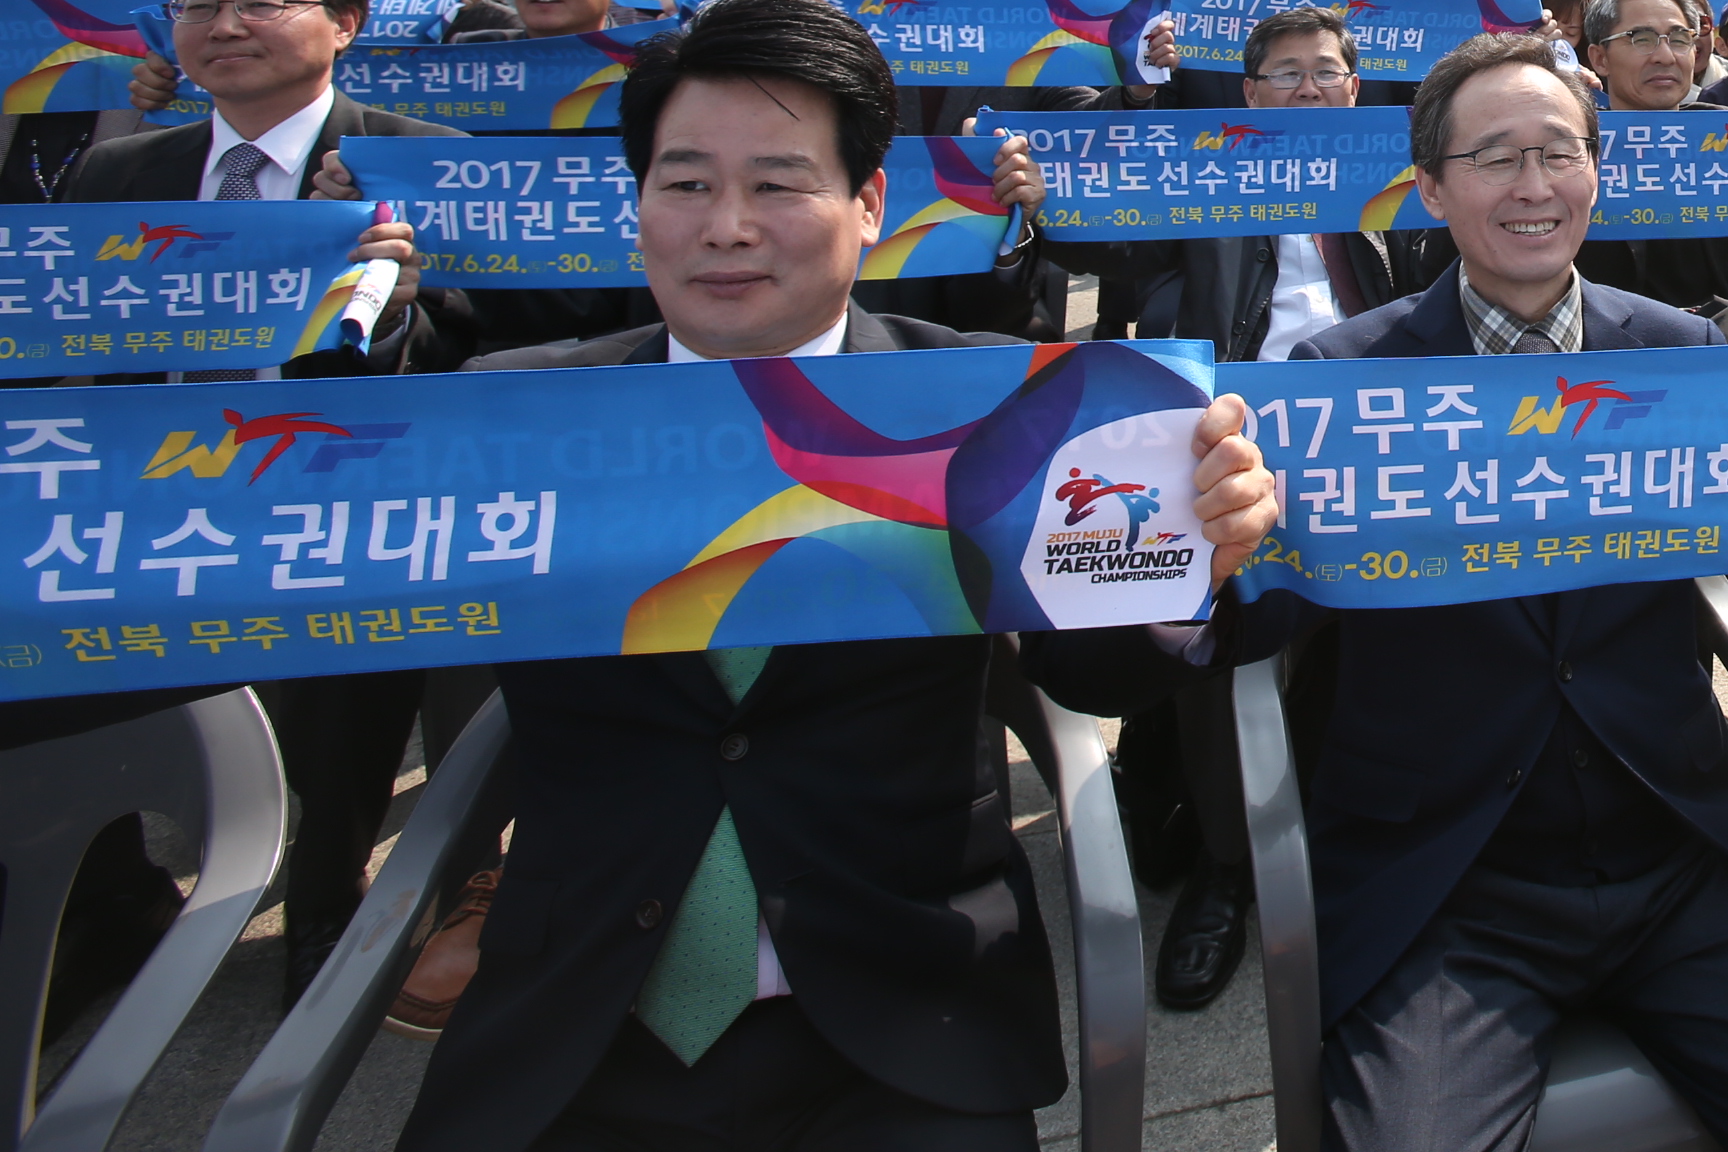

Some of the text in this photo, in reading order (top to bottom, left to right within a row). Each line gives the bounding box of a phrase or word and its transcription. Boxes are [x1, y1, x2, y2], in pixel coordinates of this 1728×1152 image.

[910, 60, 969, 75] 태권도원
[436, 101, 506, 117] 태권도원
[1105, 123, 1178, 158] 무주
[1623, 124, 1689, 160] 무주
[433, 159, 543, 196] 2017
[1168, 205, 1205, 224] 전북
[1210, 204, 1244, 224] 무주
[1250, 202, 1318, 221] 태권도원
[1679, 205, 1710, 223] 전북
[94, 221, 236, 264] WTF
[61, 334, 113, 357] 전북
[123, 331, 174, 355] 무주
[182, 326, 276, 351] 태권도원
[1352, 384, 1484, 456] 무주
[1506, 375, 1669, 441] WTF
[139, 408, 412, 487] WTF
[22, 490, 558, 603] 선수권대회
[1046, 528, 1124, 543] 2017 MUJU
[1046, 539, 1121, 557] WORLD
[1461, 541, 1523, 576] 전북
[1533, 536, 1593, 567] 무주
[1604, 525, 1720, 562] 태권도원
[1044, 548, 1194, 575] TAEKWONDO
[1091, 568, 1187, 583] CHAMPIONSHIPS
[61, 622, 169, 663] 전북
[187, 614, 290, 655] 무주
[306, 601, 503, 647] 태권도원
